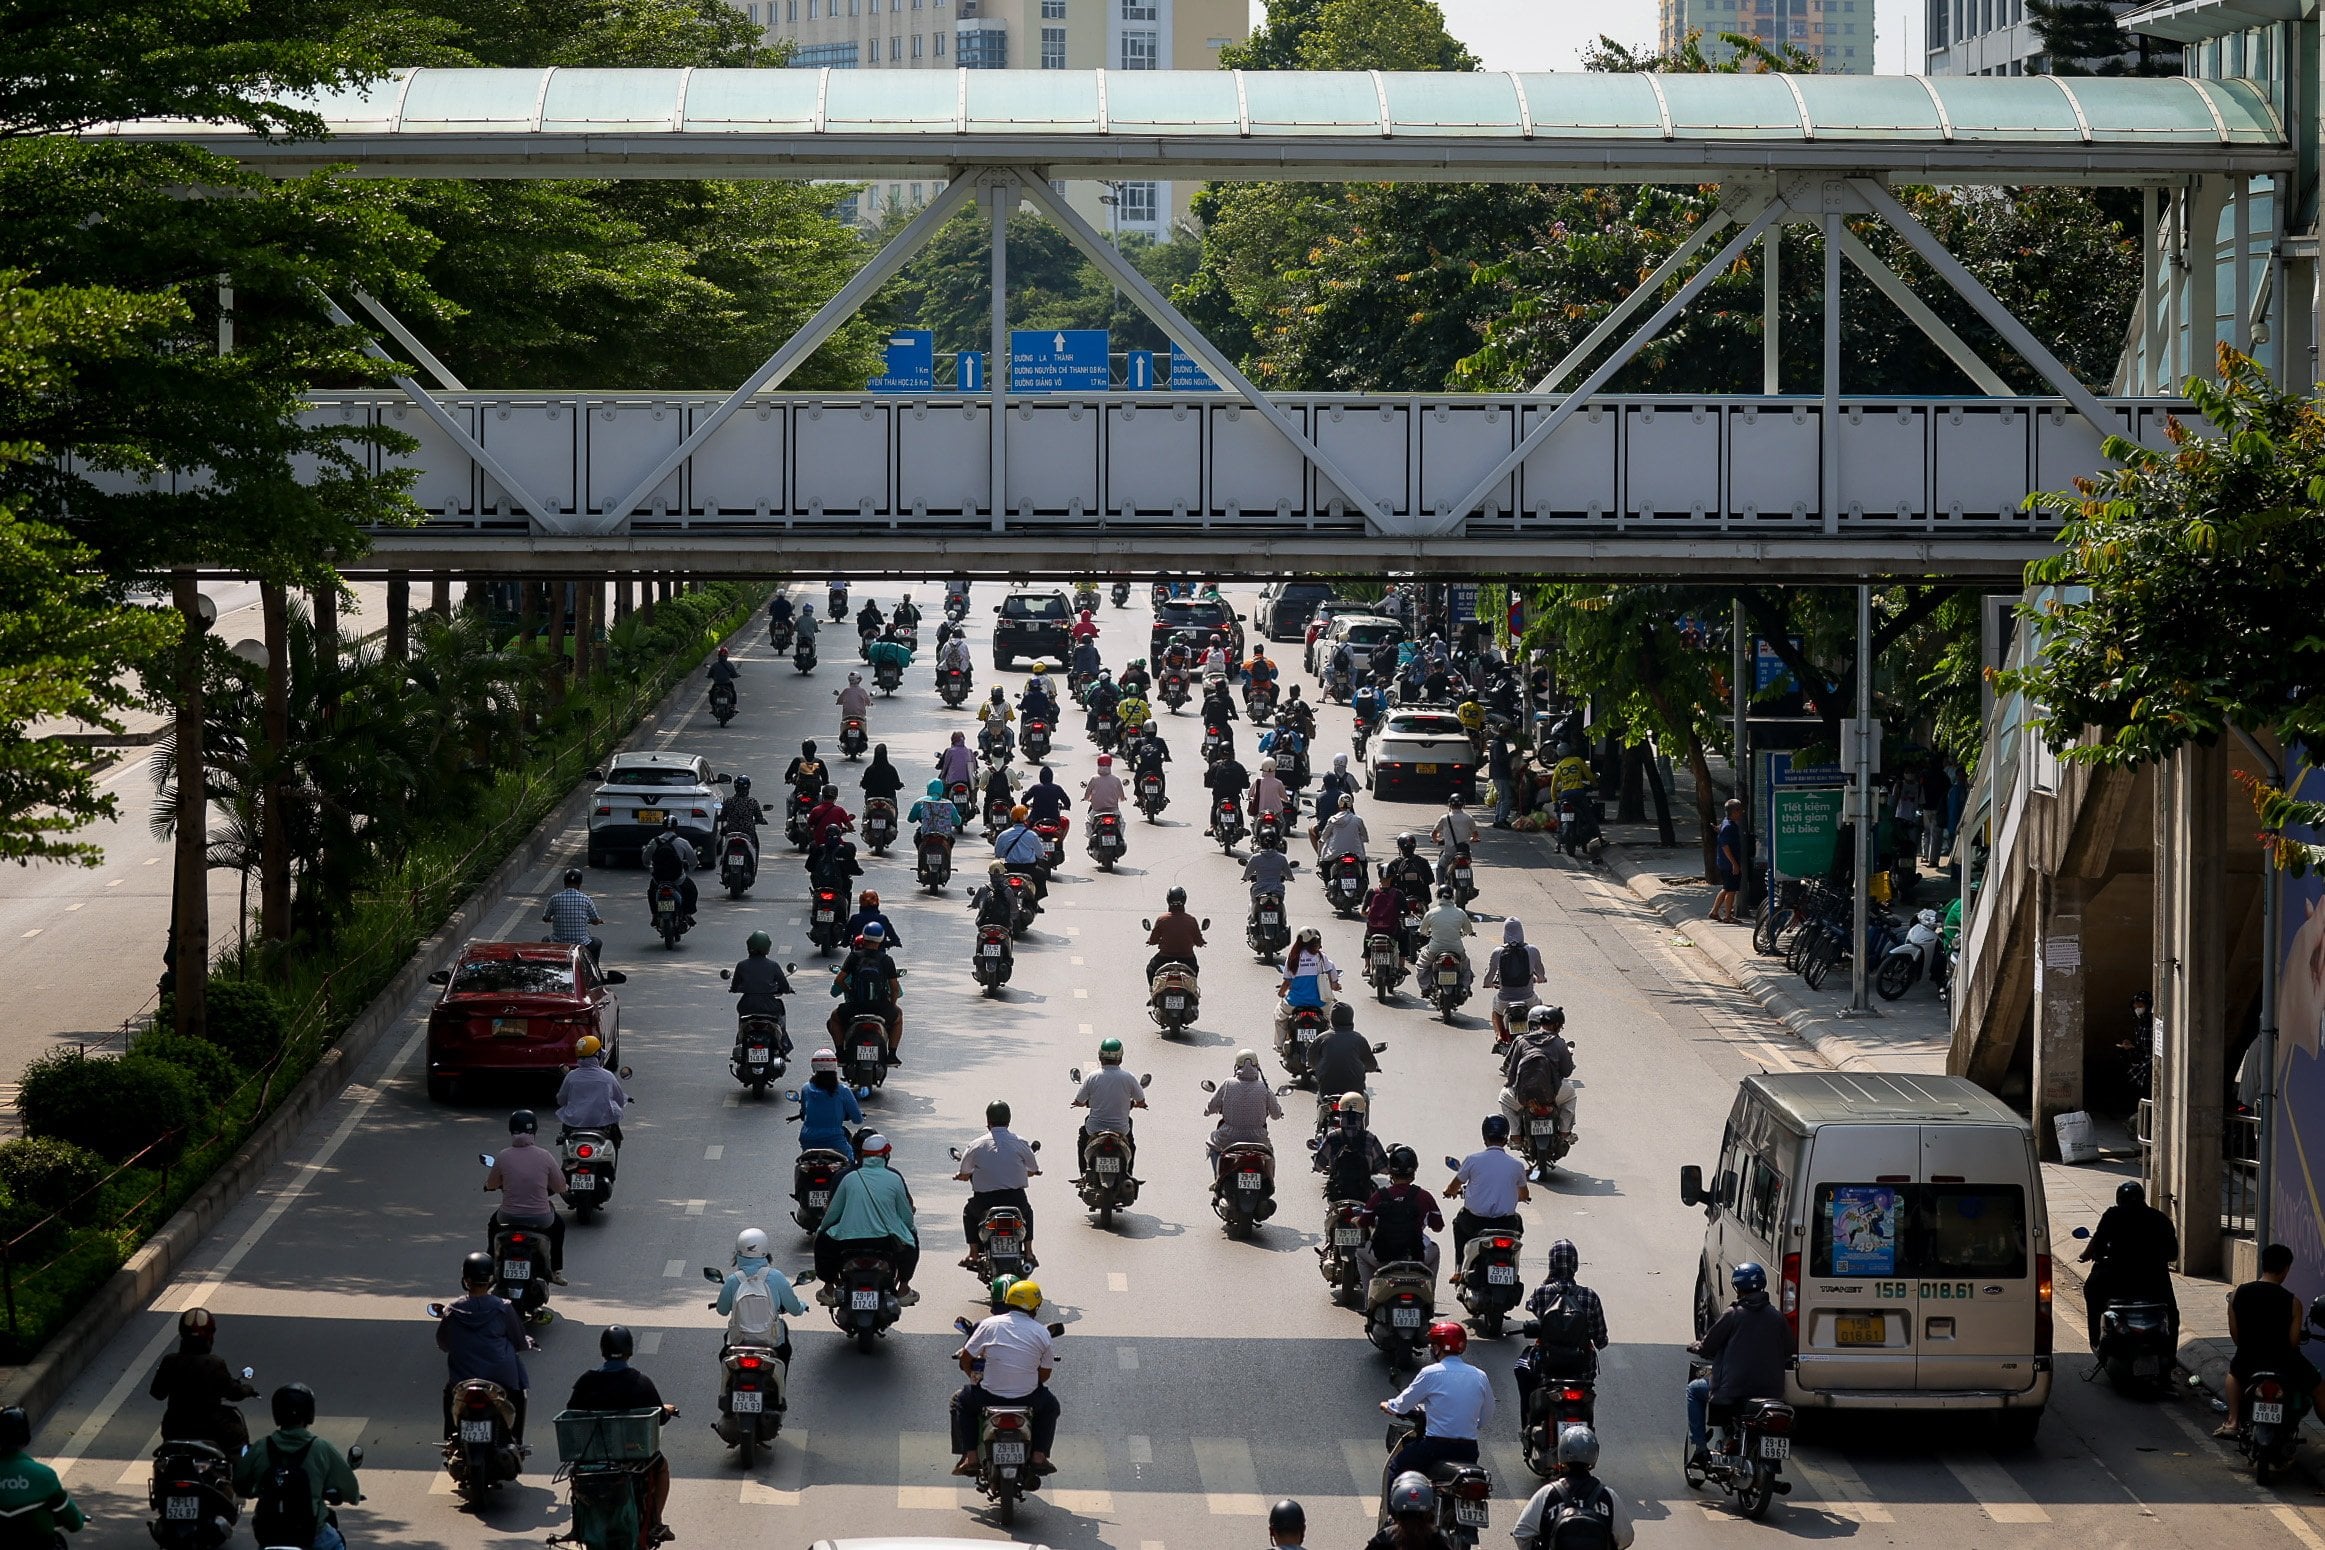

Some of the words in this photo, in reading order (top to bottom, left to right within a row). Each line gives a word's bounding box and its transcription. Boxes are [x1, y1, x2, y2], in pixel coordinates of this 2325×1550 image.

[1038, 354, 1048, 362] LA
[1782, 802, 1801, 812] Tiết
[1782, 812, 1802, 823] thời
[1805, 813, 1828, 823] gian
[1798, 824, 1820, 833] bike
[852, 1300, 878, 1309] 812.46
[1850, 1319, 1871, 1330] 15B
[1841, 1331, 1879, 1342] 018.61
[733, 1402, 761, 1411] 034.93
[1764, 1447, 1786, 1458] 6962
[995, 1454, 1023, 1463] 662.39
